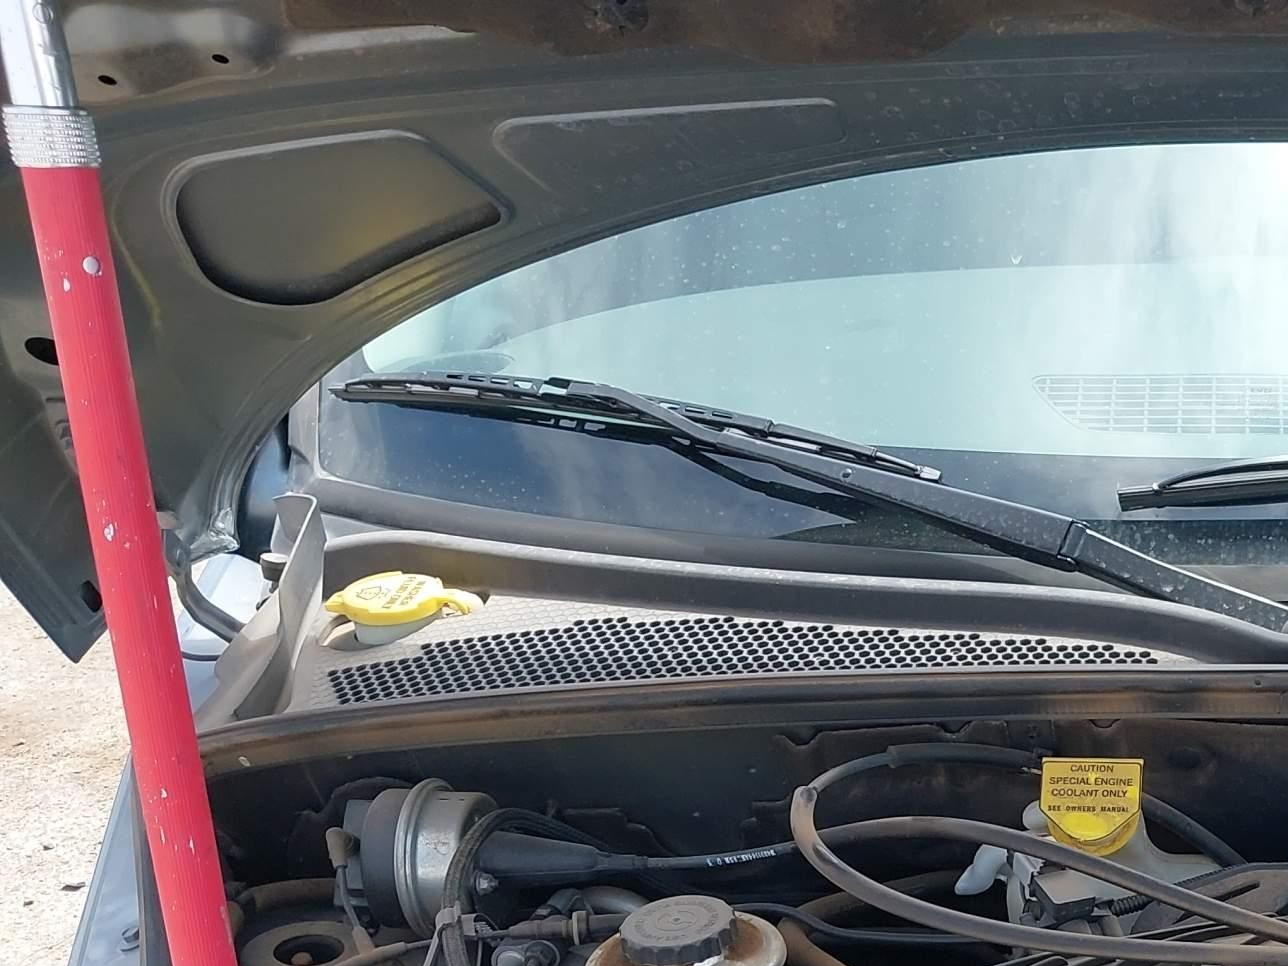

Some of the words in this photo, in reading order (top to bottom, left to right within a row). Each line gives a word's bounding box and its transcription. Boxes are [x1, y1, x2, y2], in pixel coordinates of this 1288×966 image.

[1070, 764, 1114, 773] CAUTION
[1048, 776, 1093, 786] SPECIAL
[1094, 777, 1134, 787] ENGINE
[1050, 788, 1100, 797] COOLANT
[1101, 788, 1128, 798] ONLY
[1047, 804, 1061, 812] SEE
[1065, 805, 1097, 813] OWNERS
[1100, 805, 1129, 813] MANUAL
